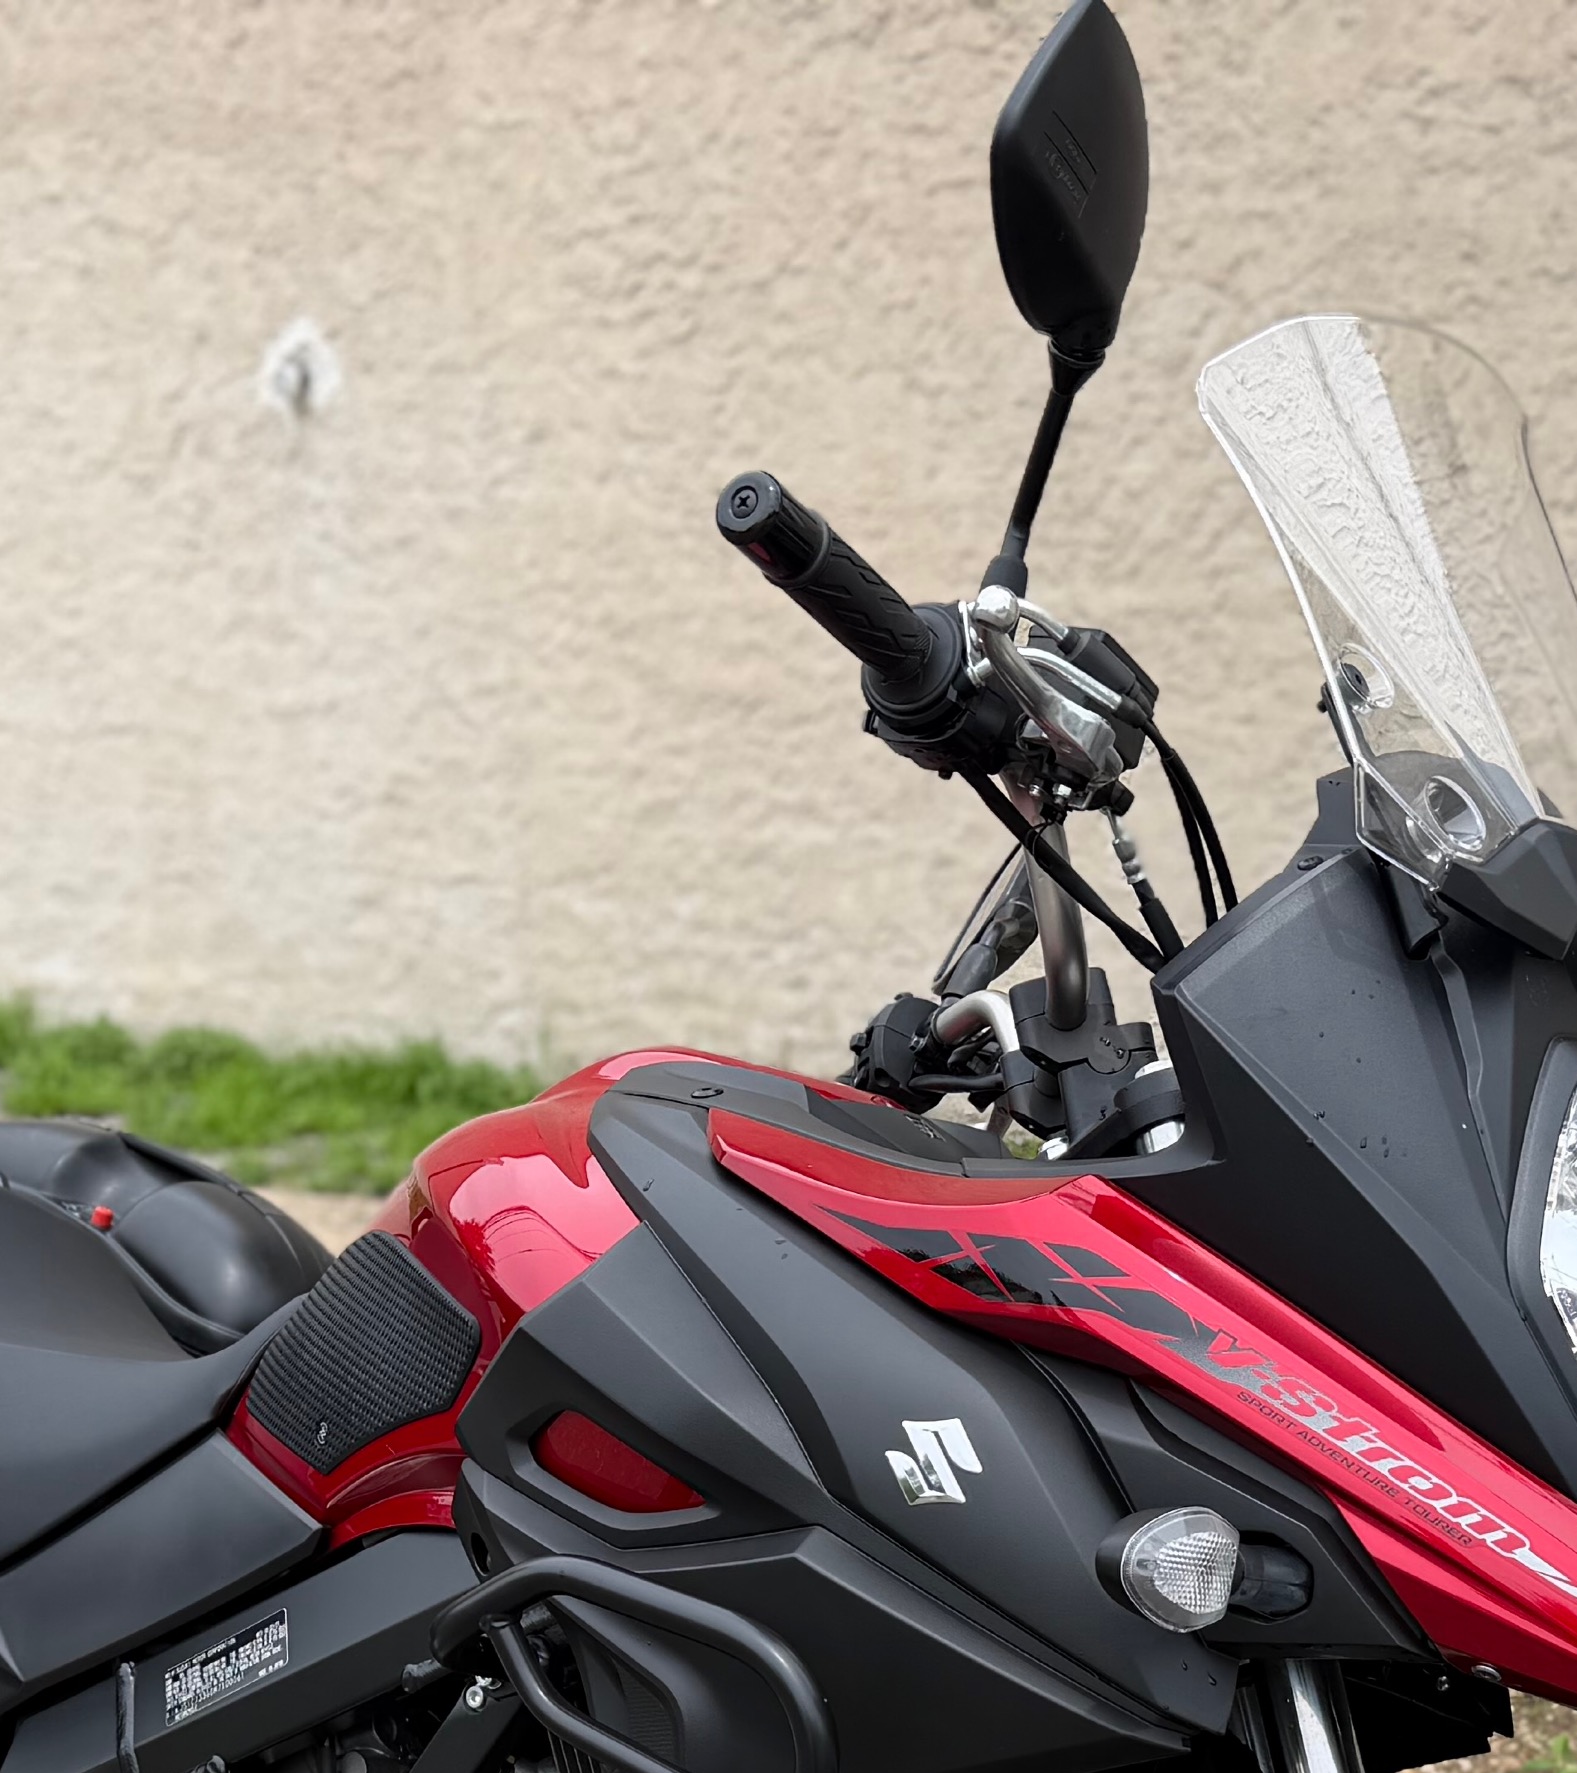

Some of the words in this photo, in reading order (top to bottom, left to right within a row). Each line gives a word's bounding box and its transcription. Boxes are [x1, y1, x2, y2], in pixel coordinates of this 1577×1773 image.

[1208, 1327, 1532, 1560] V-Strom
[1236, 1390, 1297, 1432] SPORT
[1296, 1429, 1400, 1499] ADVENTURE
[1404, 1498, 1474, 1547] TOURER
